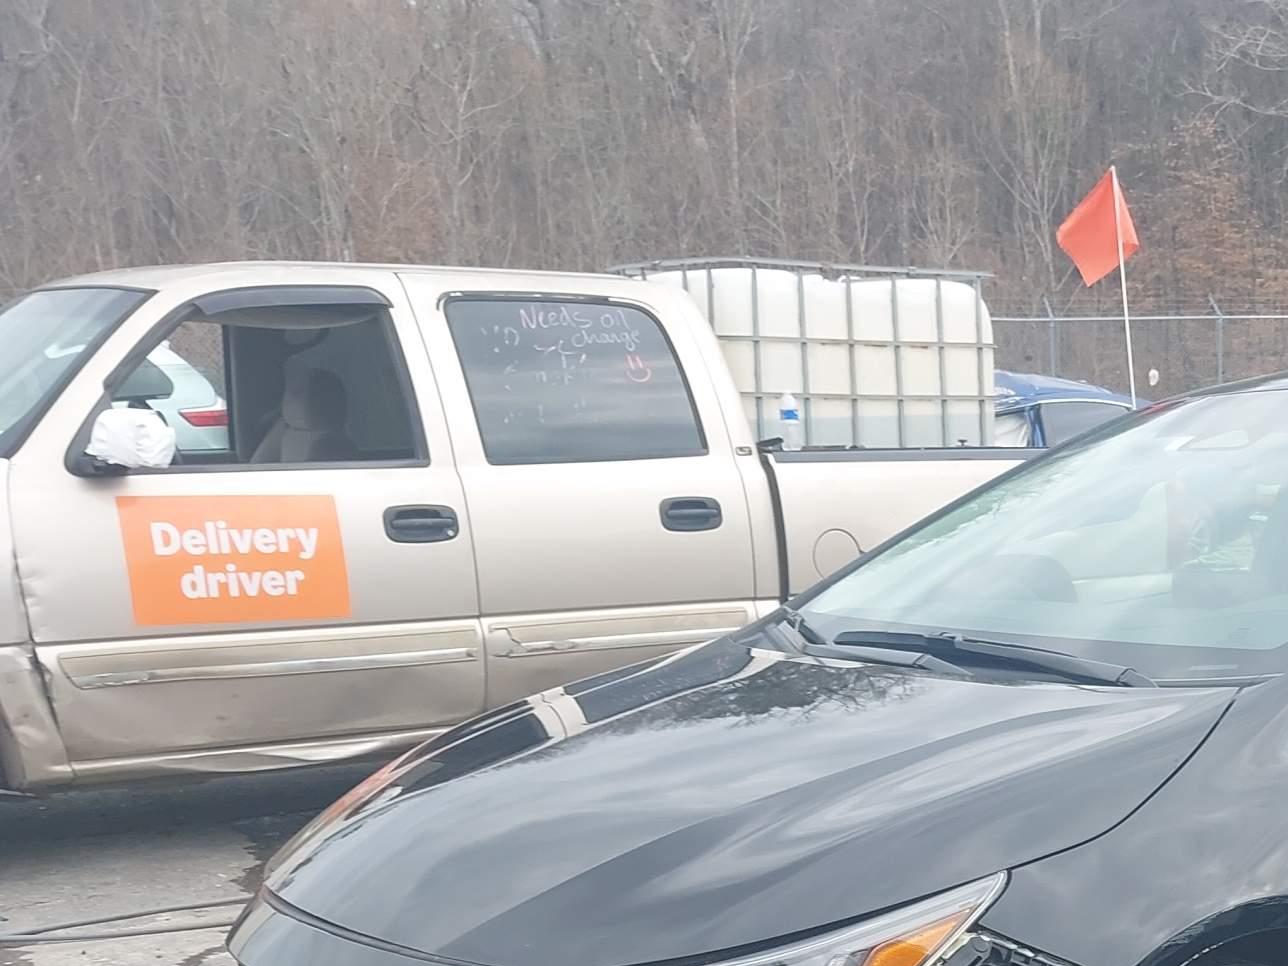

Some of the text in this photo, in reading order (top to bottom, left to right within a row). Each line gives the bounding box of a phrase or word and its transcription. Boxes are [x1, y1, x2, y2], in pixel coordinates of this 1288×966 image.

[520, 306, 631, 330] Needs oil
[571, 329, 641, 352] change
[150, 520, 319, 559] Delivery
[180, 563, 305, 599] driver
